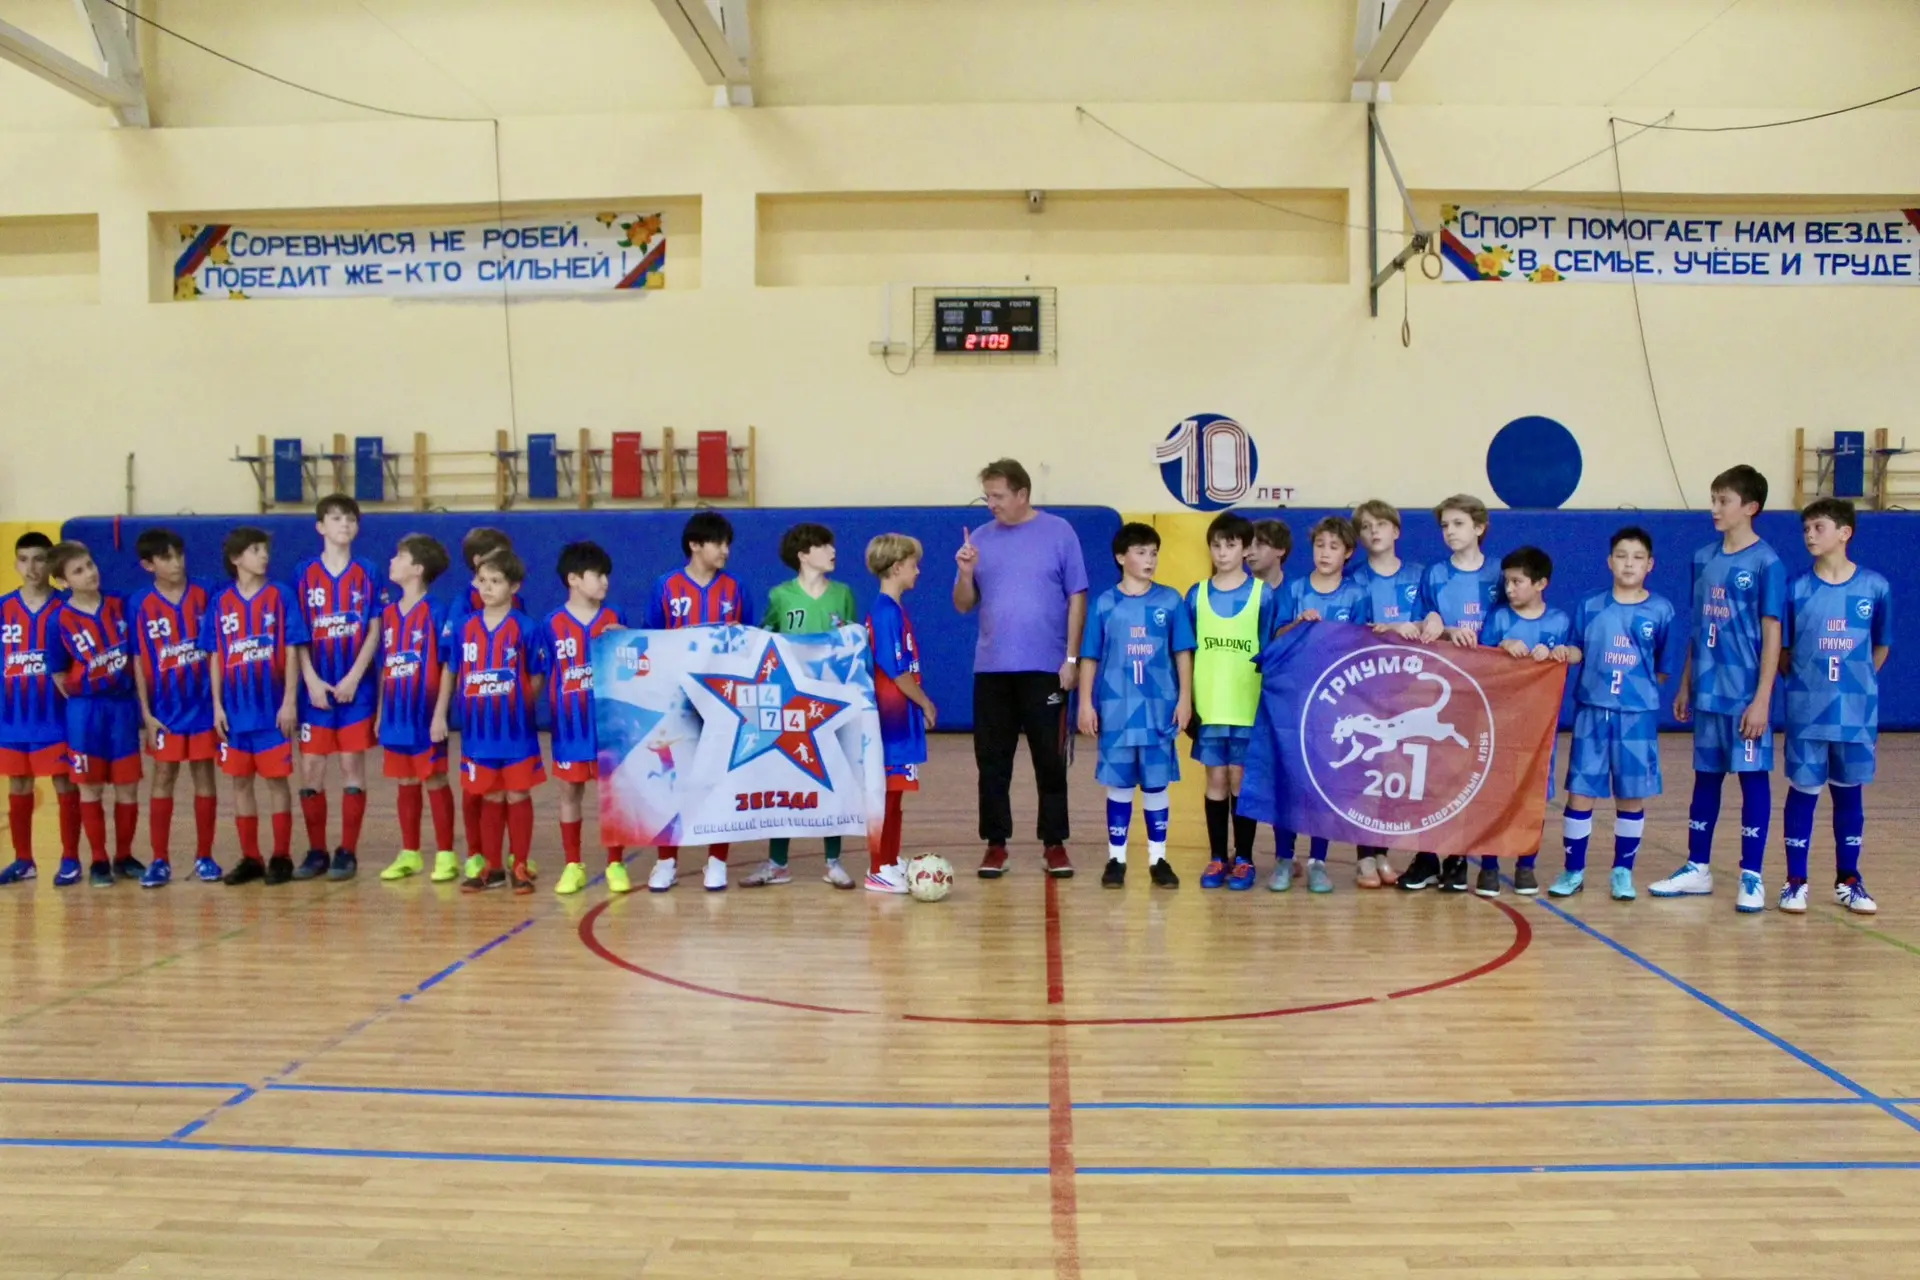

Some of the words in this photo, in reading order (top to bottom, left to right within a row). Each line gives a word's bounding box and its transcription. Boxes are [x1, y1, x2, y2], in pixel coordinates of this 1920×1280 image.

[1460, 210, 1556, 239] СПОРТ
[1568, 216, 1723, 243] ПОМОГАЕТ
[1735, 220, 1795, 244] НАМ
[230, 229, 415, 257] СОРЕВНУЙСЯ
[429, 230, 466, 252] НЕ
[1518, 249, 1538, 272] В
[1674, 246, 1770, 275] УЧЁБЕ
[1781, 252, 1801, 276] И
[204, 265, 332, 289] ПОБЕДИТ
[1151, 419, 1250, 504] 10
[1257, 487, 1295, 500] ЛЕТ
[307, 587, 326, 608] 26
[669, 596, 693, 618] 37
[1, 624, 23, 644] 22
[146, 617, 172, 639] 23
[220, 612, 240, 635] 25
[1707, 622, 1716, 648] 9
[1827, 619, 1847, 632] ШСК
[72, 629, 96, 653] 21
[462, 642, 478, 662] 18
[555, 637, 577, 660] 28
[1204, 637, 1252, 653] SPALDING
[1613, 635, 1631, 649] ШСК
[1818, 637, 1854, 651] ТРИУМФ
[1132, 660, 1144, 685] 11
[1319, 654, 1425, 706] ТРИУМФ
[1828, 655, 1840, 682] 6
[1610, 669, 1622, 695] 2
[1744, 739, 1754, 762] 9
[73, 754, 89, 774] 21
